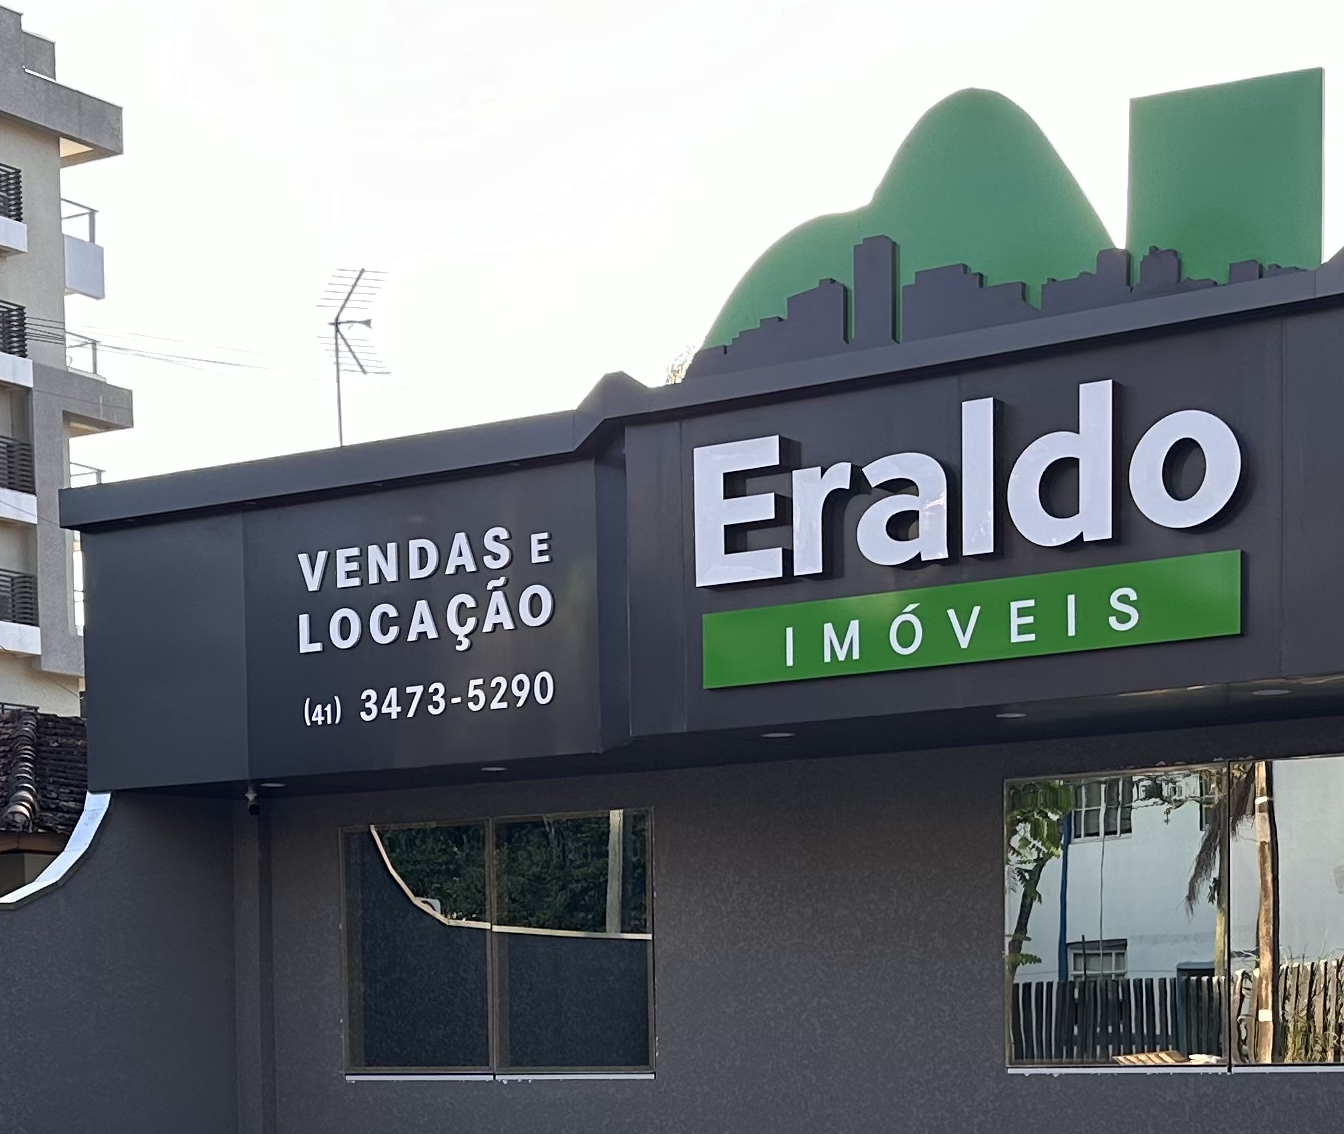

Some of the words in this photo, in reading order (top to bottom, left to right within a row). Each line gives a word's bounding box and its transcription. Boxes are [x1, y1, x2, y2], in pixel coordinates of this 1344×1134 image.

[693, 379, 1242, 588] Eraldo
[297, 526, 513, 593] VENDAS
[529, 531, 552, 564] E
[298, 576, 554, 654] LOCAÇÃO
[785, 587, 1140, 667] IMÓVEIS
[304, 695, 342, 727] (41)
[359, 670, 555, 723] 3473-5290
